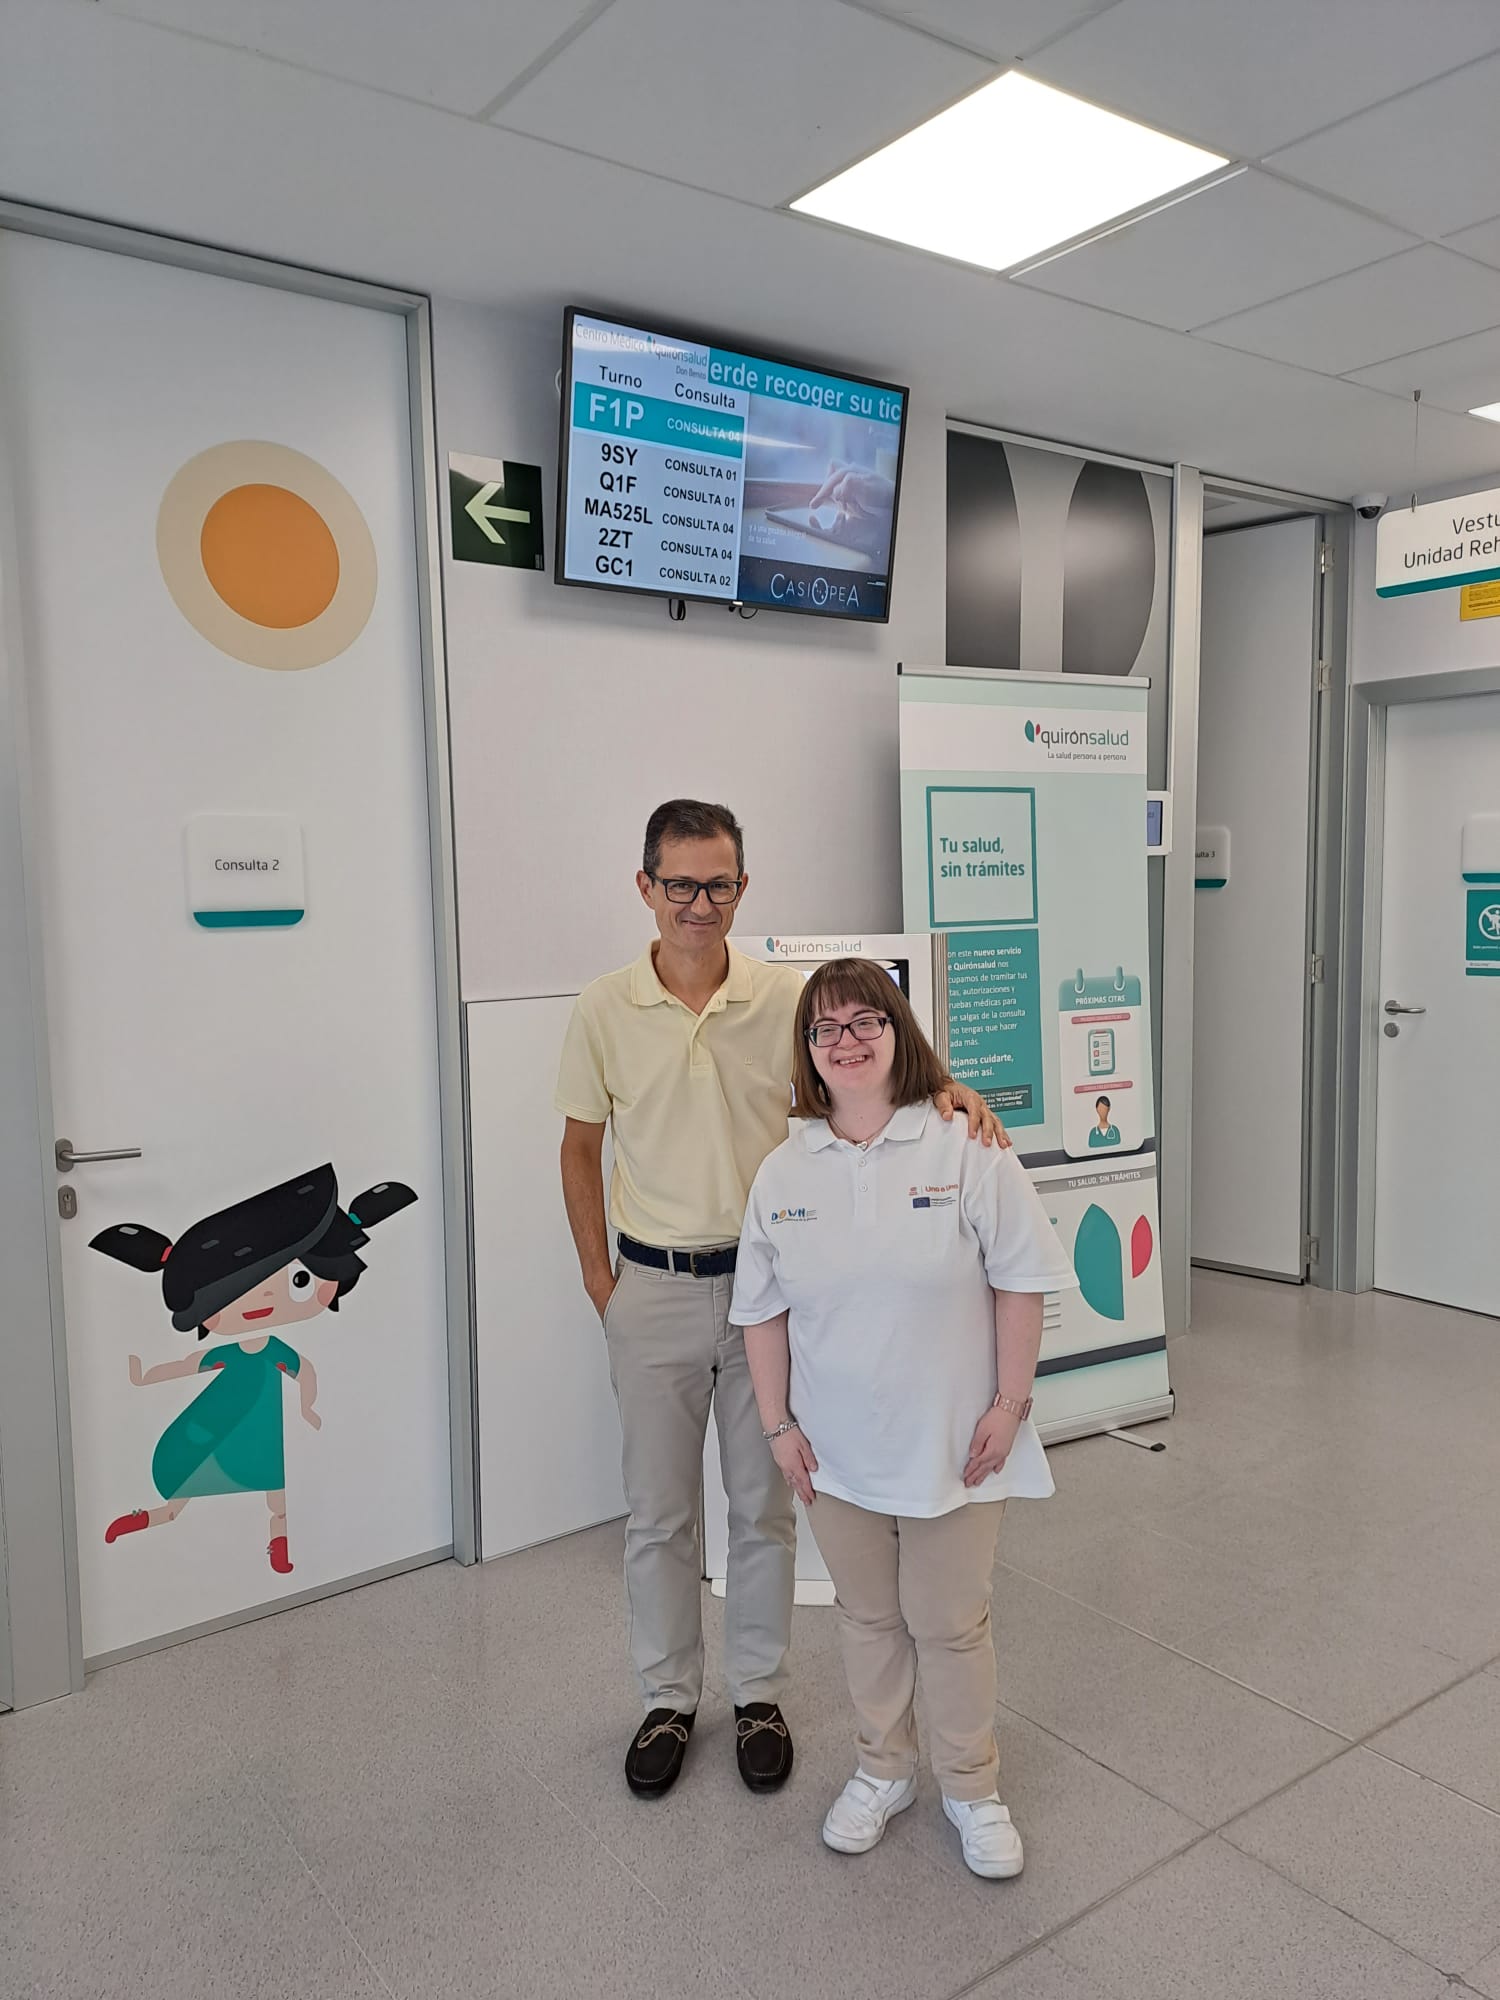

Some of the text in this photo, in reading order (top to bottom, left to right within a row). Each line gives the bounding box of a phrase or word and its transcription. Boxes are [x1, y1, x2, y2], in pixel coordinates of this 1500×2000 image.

[575, 323, 607, 343] Centro
[599, 365, 735, 409] Turno Consulta
[710, 362, 901, 420] erde recoger su tic
[589, 393, 644, 429] F1P
[667, 418, 728, 438] CONSULTA
[601, 443, 737, 481] 9SY CONSULTA 01
[600, 472, 735, 508] Q1F CONSULTA 01
[585, 497, 653, 525] MA525L
[662, 513, 720, 532] CONSULTA
[723, 523, 734, 534] 04
[1453, 513, 1500, 534] Vestu
[598, 528, 732, 560] 2ZT CONSULTA 04
[1404, 542, 1463, 568] Unidad
[595, 555, 731, 586] GC1 CONSULTA 02
[1041, 728, 1129, 749] quirónsalud
[1047, 751, 1054, 759] La
[1056, 751, 1071, 759] salud
[1103, 753, 1126, 761] persona
[940, 837, 1004, 854] Tu salud,
[214, 859, 280, 871] Consulta 2
[941, 860, 1025, 877] sin trámites
[958, 950, 972, 958] este
[996, 946, 1022, 956] servicio
[953, 960, 996, 971] Quirónsalud
[980, 973, 989, 982] de
[990, 972, 1016, 981] tramitar
[963, 985, 1010, 996] autorizaciones
[973, 998, 1001, 1007] médicas
[1002, 998, 1017, 1006] para
[1108, 994, 1125, 1003] CITAS
[959, 1012, 979, 1022] salgas
[981, 1011, 990, 1019] de
[999, 1009, 1026, 1018] consulta
[951, 1021, 1017, 1035] no tengas que hacer
[980, 1053, 1014, 1064] cuidarte,
[981, 1066, 994, 1077] así.
[1068, 1180, 1076, 1188] TU
[1099, 1174, 1110, 1183] SIN
[771, 1208, 806, 1221] DOWN
